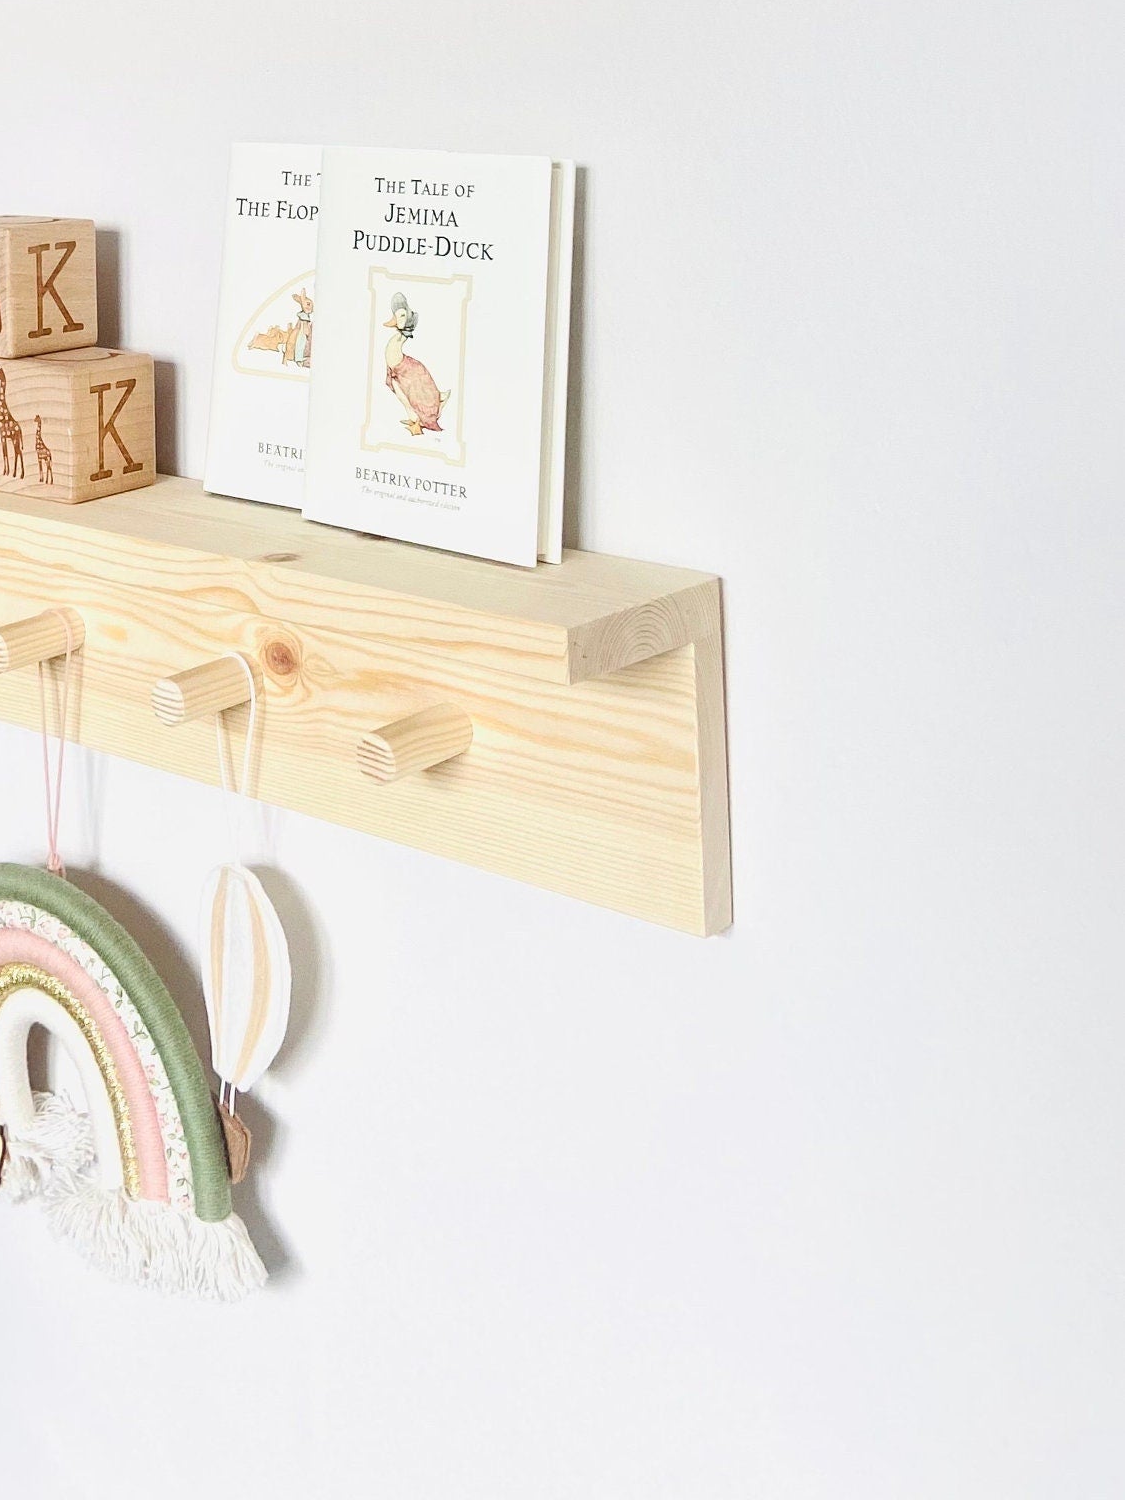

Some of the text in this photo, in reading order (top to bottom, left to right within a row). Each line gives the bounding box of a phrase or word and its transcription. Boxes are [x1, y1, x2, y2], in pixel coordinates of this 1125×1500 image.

[281, 171, 312, 187] THE
[375, 177, 476, 198] THE TALE OF
[236, 197, 319, 221] THE FLOP
[384, 203, 459, 228] JEMIMA
[352, 230, 494, 261] PUDDLE-DUCK
[27, 240, 84, 339] K
[89, 378, 144, 482] K
[258, 442, 303, 460] BEATRI
[355, 466, 468, 499] BEATRIX POTTER
